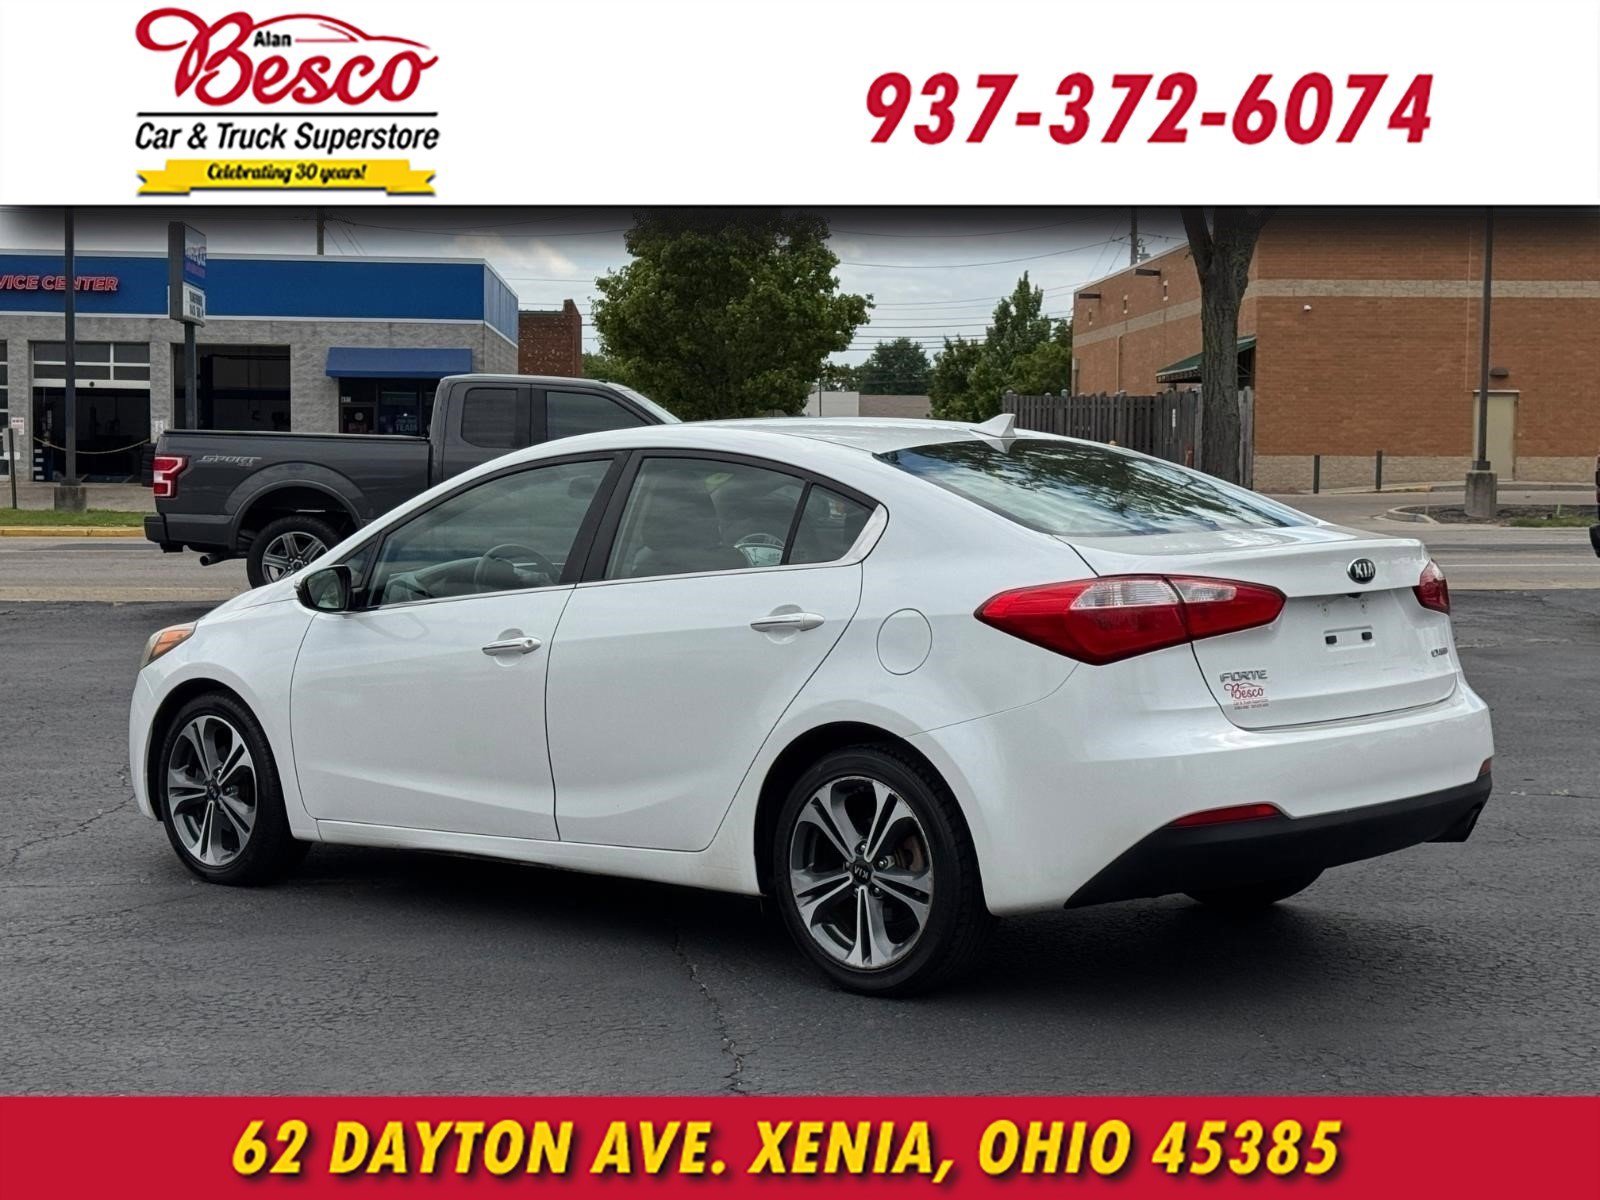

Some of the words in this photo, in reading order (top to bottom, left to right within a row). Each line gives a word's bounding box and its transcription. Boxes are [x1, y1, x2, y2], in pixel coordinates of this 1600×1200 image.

[195, 454, 262, 464] SPORT
[1352, 561, 1376, 579] KIA
[1219, 669, 1268, 682] FORTE
[1224, 682, 1264, 699] Besco
